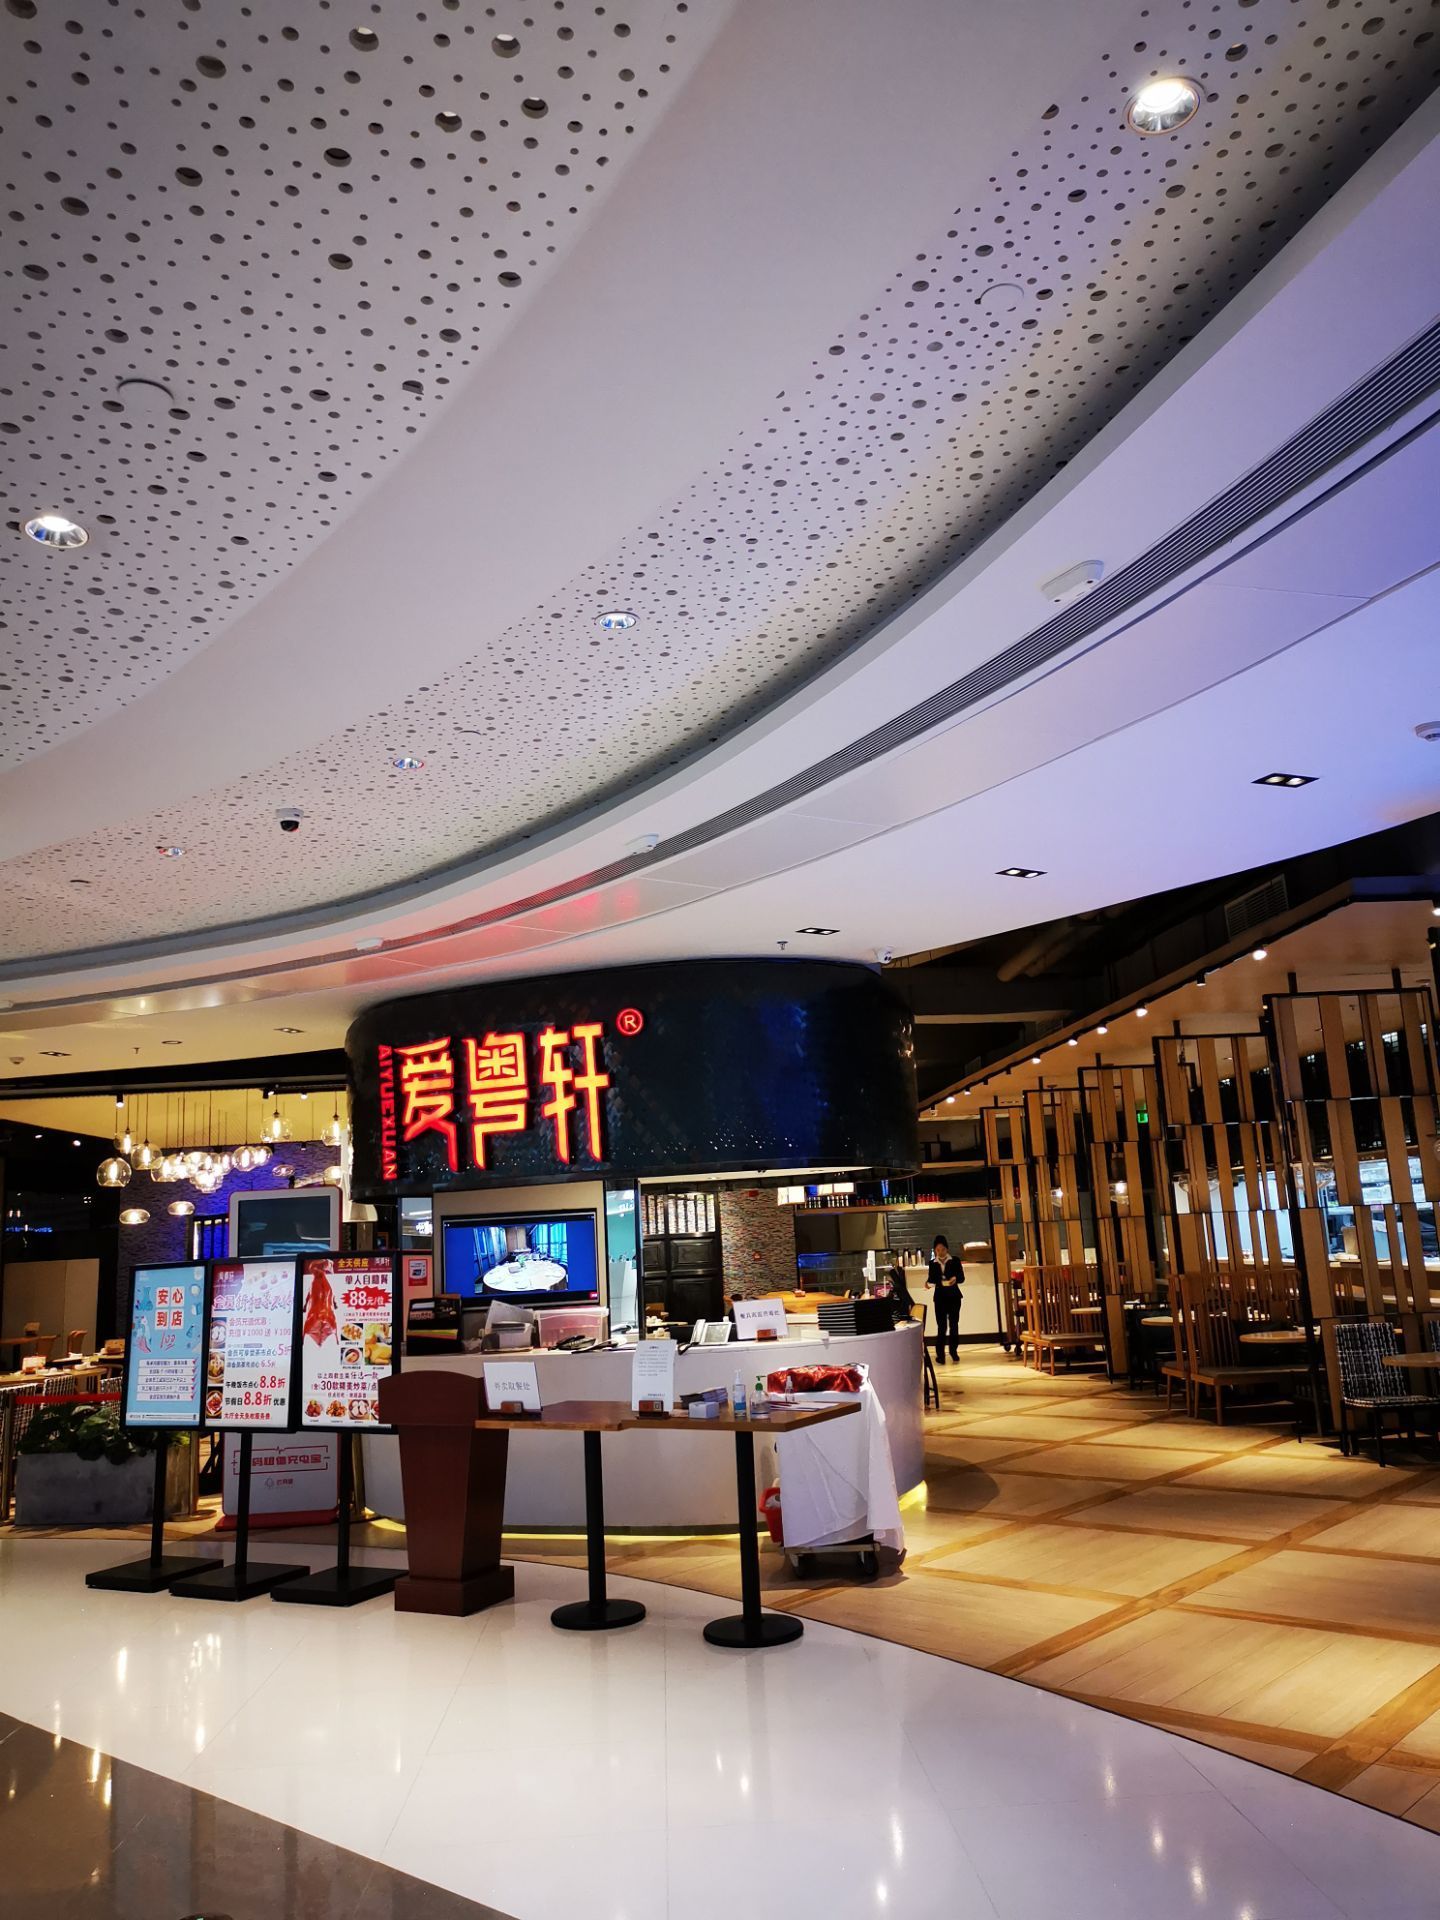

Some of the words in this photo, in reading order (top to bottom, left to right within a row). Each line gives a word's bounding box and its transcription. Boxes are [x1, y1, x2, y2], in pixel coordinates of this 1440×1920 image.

[394, 1022, 609, 1172] 爱粤轩
[378, 1044, 398, 1181] AIYUEXUAN
[338, 1258, 369, 1268] 全天供应
[157, 1288, 184, 1305] 安心
[350, 1291, 384, 1306] 88元/位
[156, 1310, 183, 1327] 到店
[252, 1454, 322, 1467] 码租借充电宝
